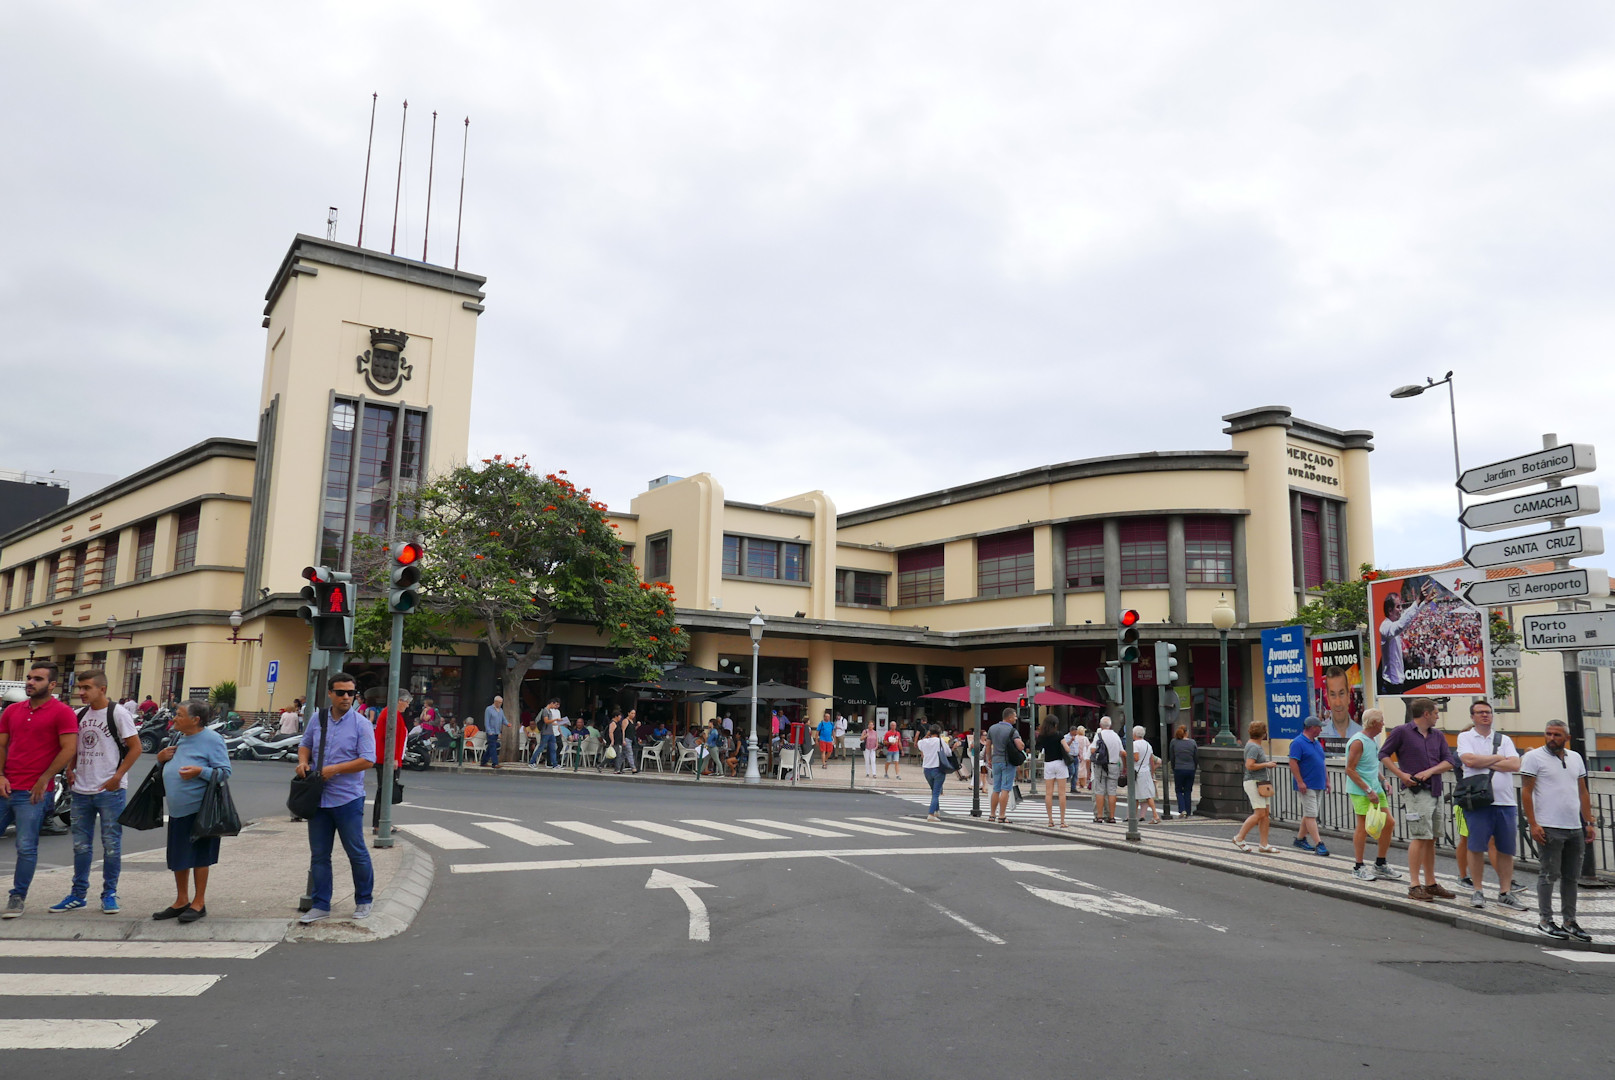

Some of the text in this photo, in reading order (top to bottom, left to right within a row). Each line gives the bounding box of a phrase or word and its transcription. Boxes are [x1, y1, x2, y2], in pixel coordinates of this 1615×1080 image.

[1287, 448, 1333, 467] MERCADO
[1304, 463, 1316, 471] DOS
[1483, 454, 1568, 483] Jardim Botânico
[1288, 467, 1339, 486] AVRADORES
[1513, 495, 1572, 514] CAMACHA
[1504, 535, 1576, 557] SANTA CRUZ
[1524, 579, 1581, 594] Aeroporto
[1531, 620, 1566, 631] Porto
[1316, 639, 1354, 652] A MADEIRA
[1532, 632, 1576, 645] Marina
[1268, 647, 1300, 664] Avançar
[1315, 654, 1358, 667] PARA TODOS
[1439, 655, 1479, 667] 28 JULHO
[1266, 659, 1303, 678] é preciso!
[1491, 659, 1518, 667] TORY
[268, 662, 277, 681] P
[1405, 666, 1480, 680] CHÃO DA LAGOA
[1271, 692, 1302, 704] Mais força
[1279, 704, 1300, 718] CDU
